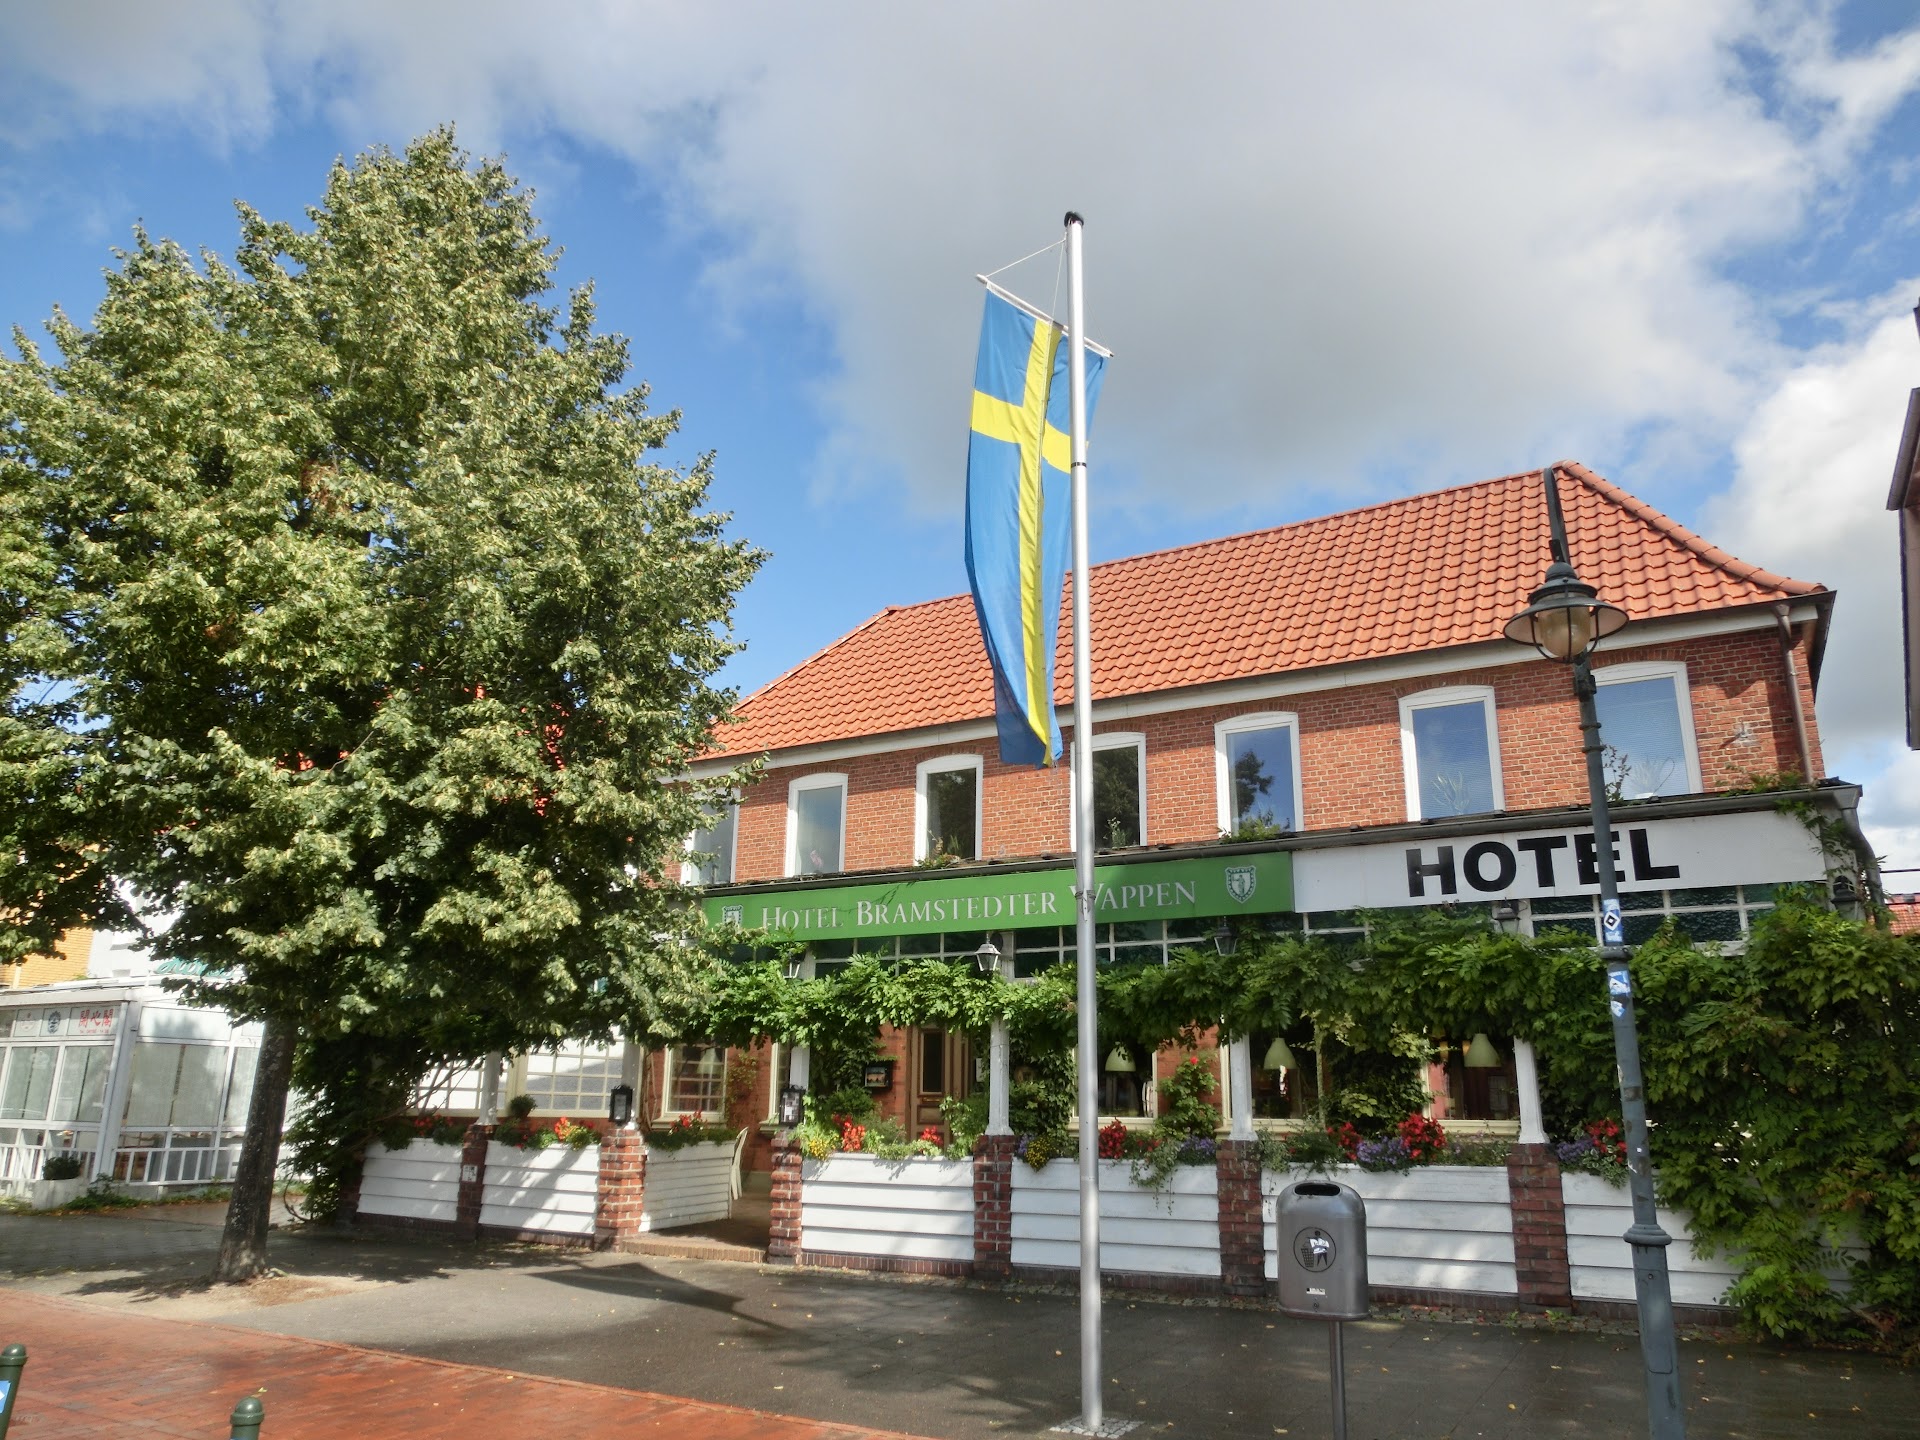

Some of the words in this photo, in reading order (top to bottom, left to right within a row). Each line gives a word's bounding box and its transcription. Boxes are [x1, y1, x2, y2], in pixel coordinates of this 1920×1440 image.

[1406, 828, 1681, 897] HOTEL
[761, 905, 844, 931] HOTEL
[856, 891, 1059, 926] BRAMSTEDTER
